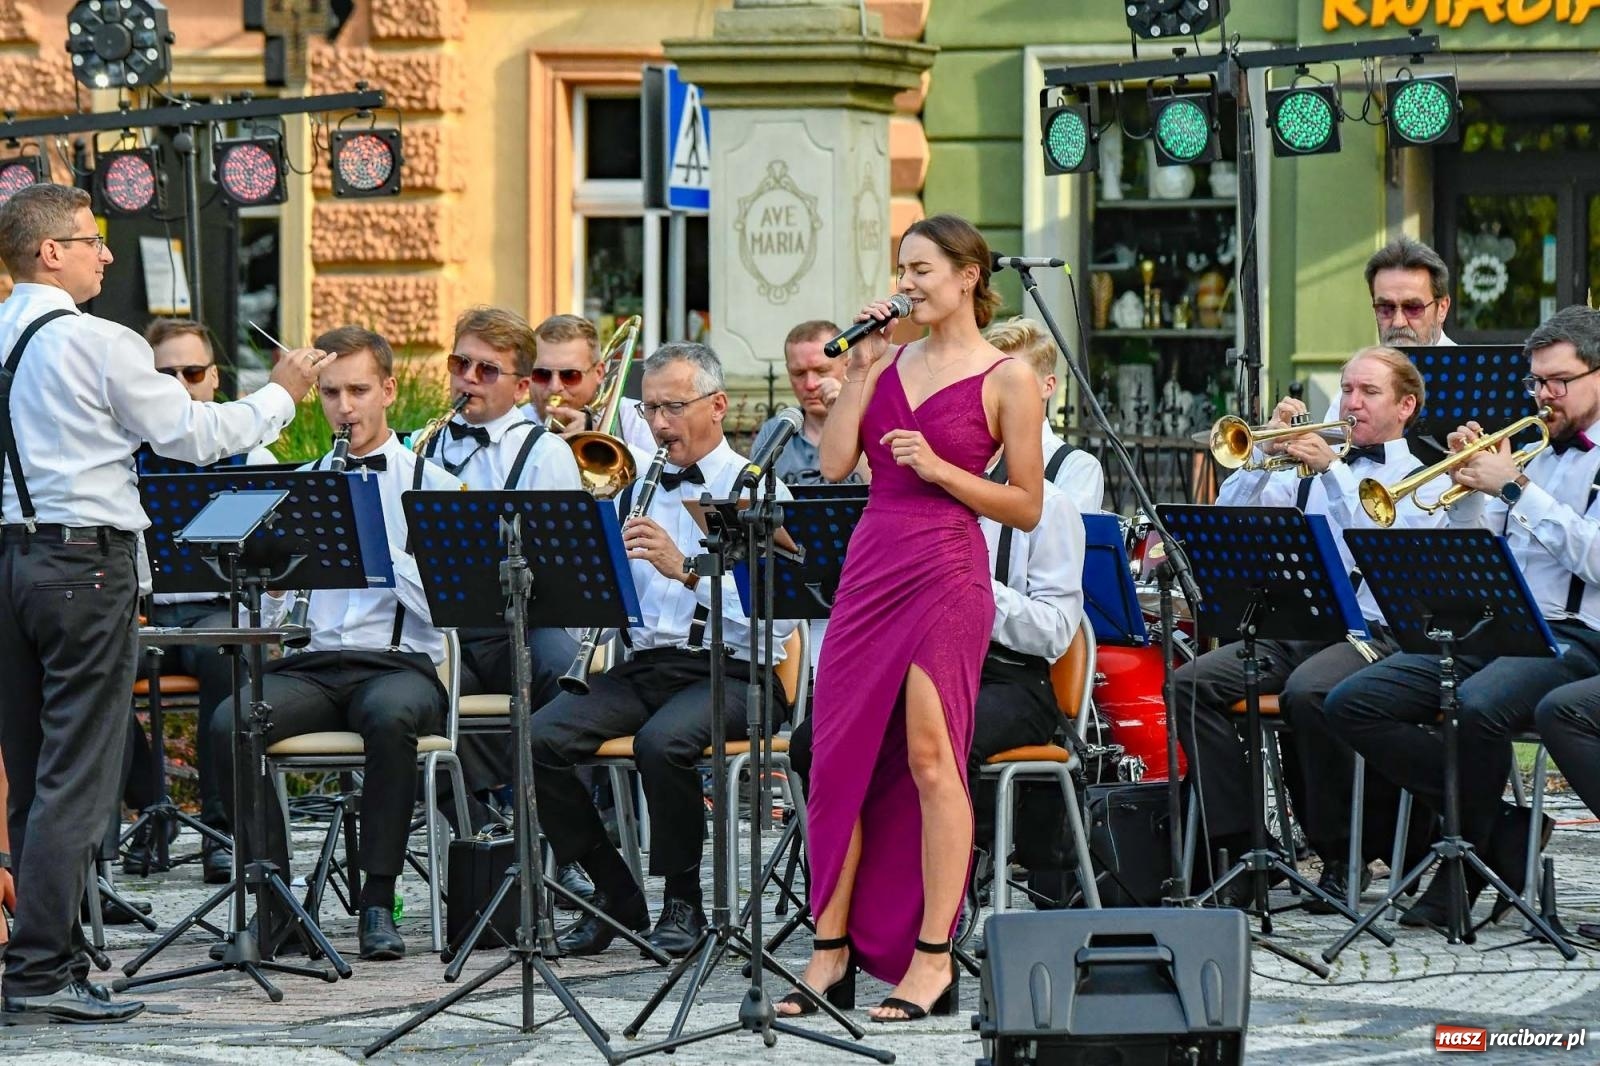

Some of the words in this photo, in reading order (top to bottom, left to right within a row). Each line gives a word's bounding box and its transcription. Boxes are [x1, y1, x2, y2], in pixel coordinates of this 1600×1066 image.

[1322, 0, 1600, 31] KWIACI
[760, 205, 799, 228] AVE
[751, 231, 805, 255] MARIA
